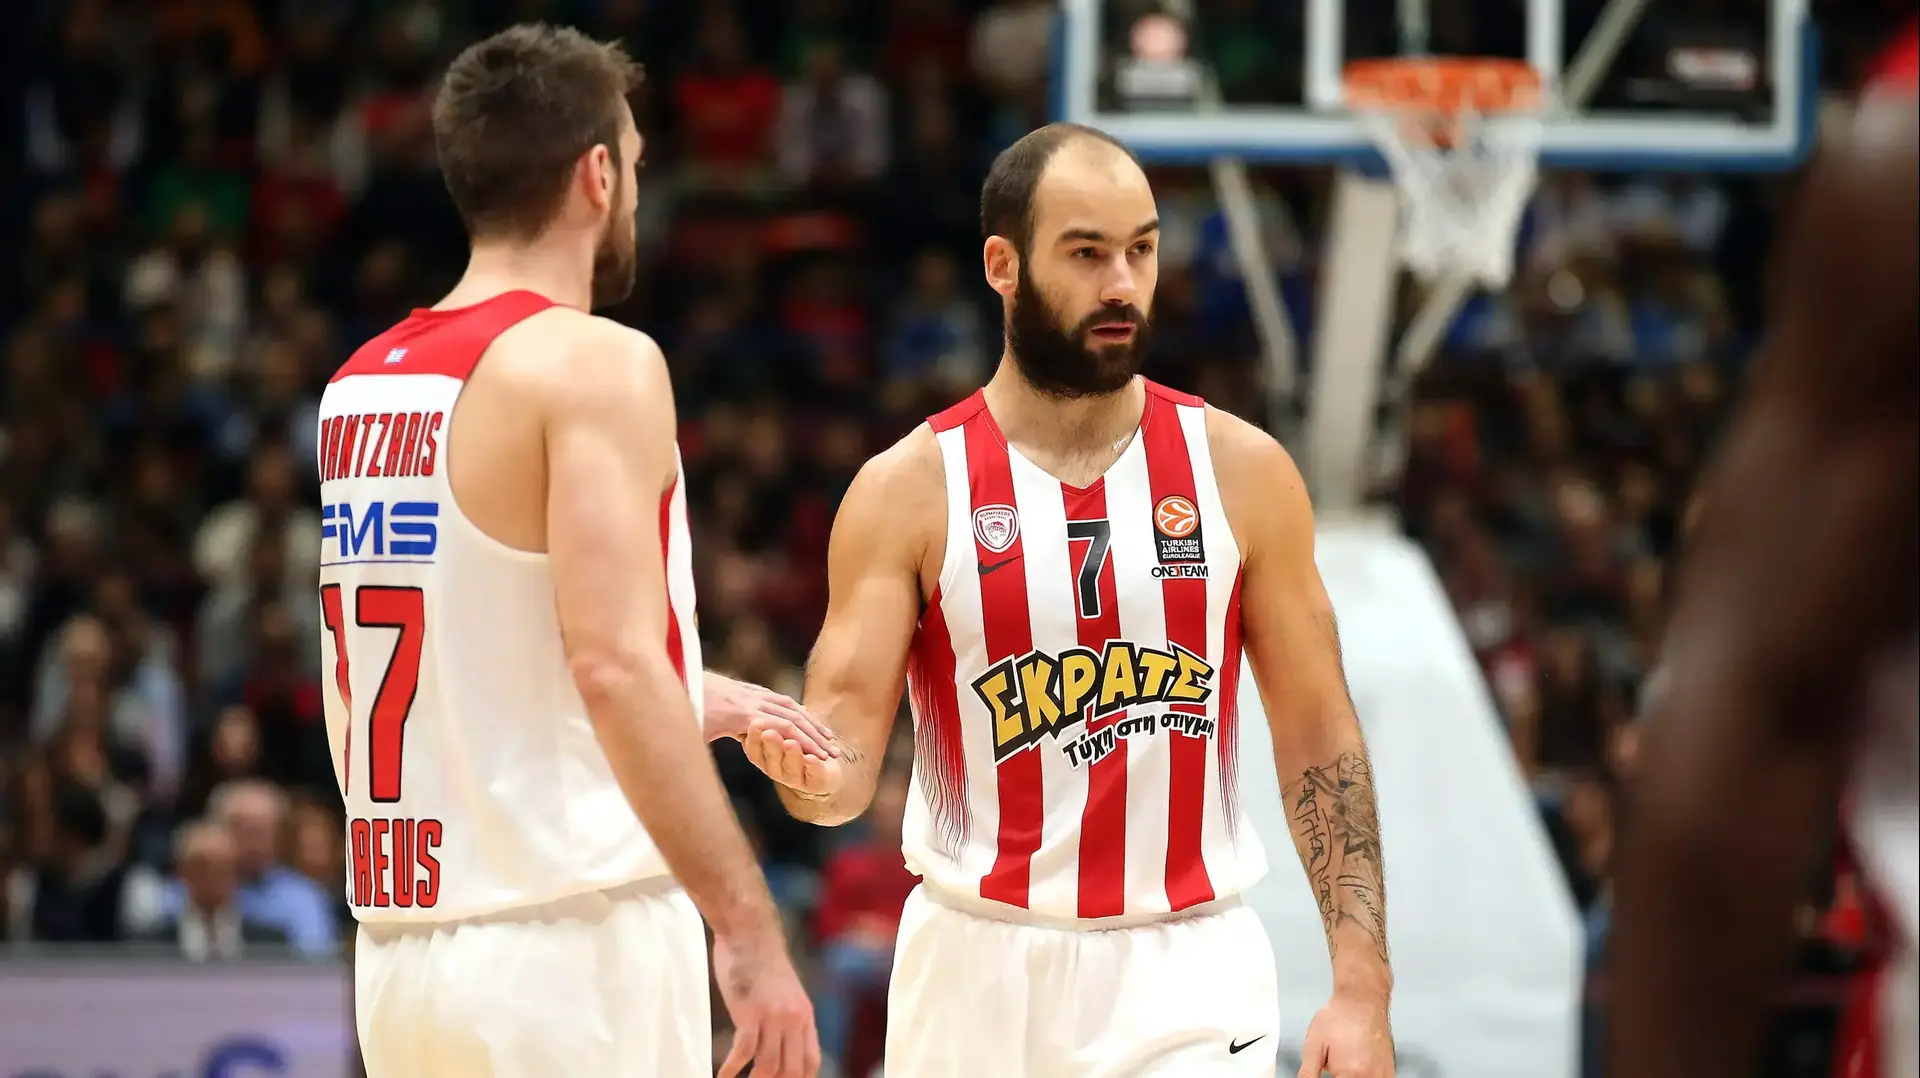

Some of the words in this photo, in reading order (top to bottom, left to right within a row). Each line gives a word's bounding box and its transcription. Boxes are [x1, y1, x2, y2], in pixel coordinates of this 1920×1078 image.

[1066, 520, 1111, 617] 7
[1160, 539, 1199, 547] TURKISH
[1161, 546, 1200, 554] AIRLINES
[320, 583, 425, 803] 17
[1062, 727, 1113, 768] Τύχη
[1117, 714, 1156, 737] στη
[346, 818, 443, 907] AEUS
